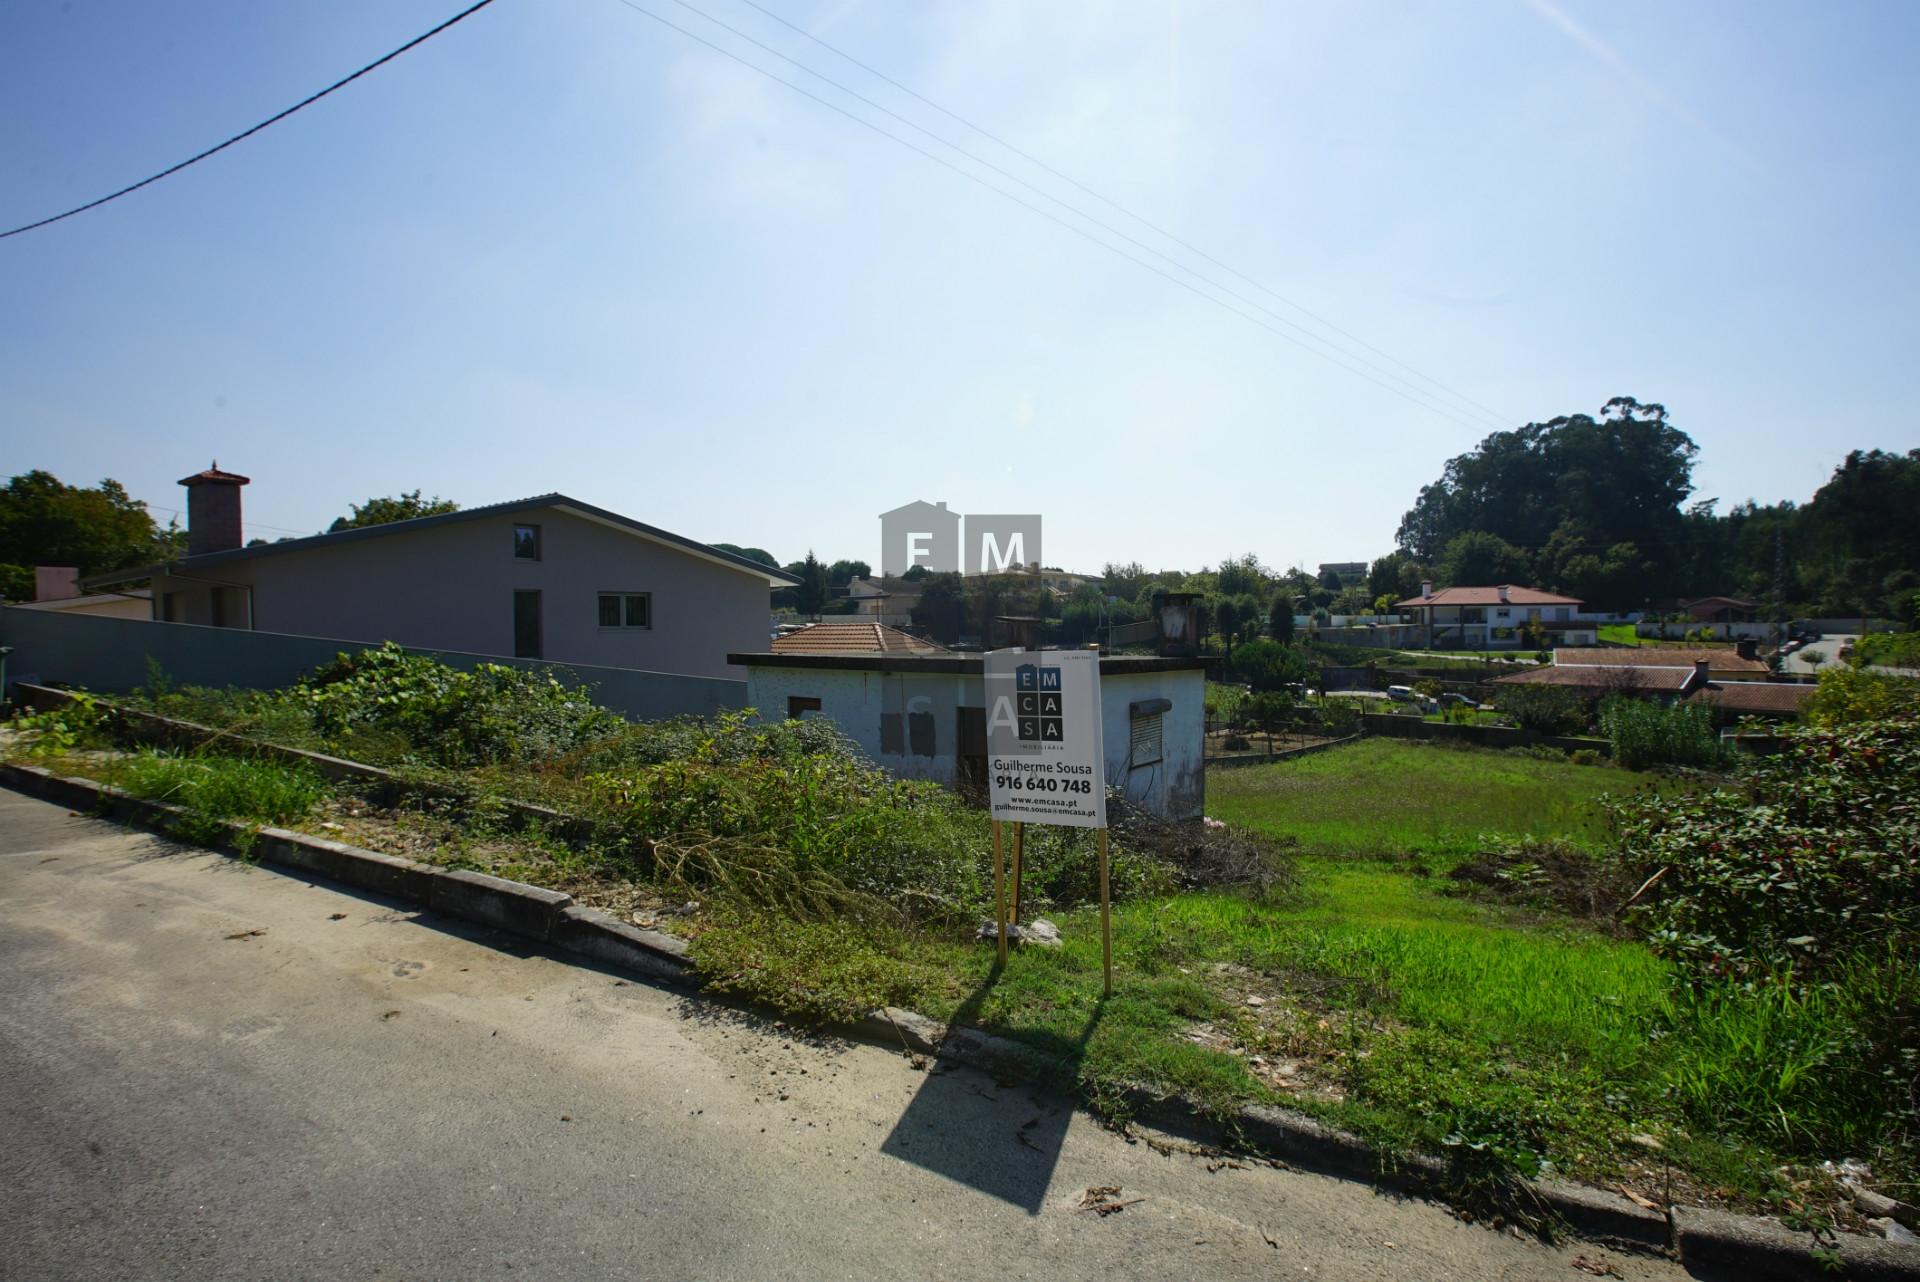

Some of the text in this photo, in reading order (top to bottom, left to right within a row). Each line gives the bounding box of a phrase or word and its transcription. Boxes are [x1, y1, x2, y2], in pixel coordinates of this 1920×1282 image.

[994, 759, 1053, 773] Guilherme
[1056, 762, 1092, 775] Sousa
[996, 775, 1091, 794] 916 640 748
[1011, 796, 1078, 808] www.emcasa.pt
[994, 803, 1096, 817] guilherme.sousa@emcasa.pt
